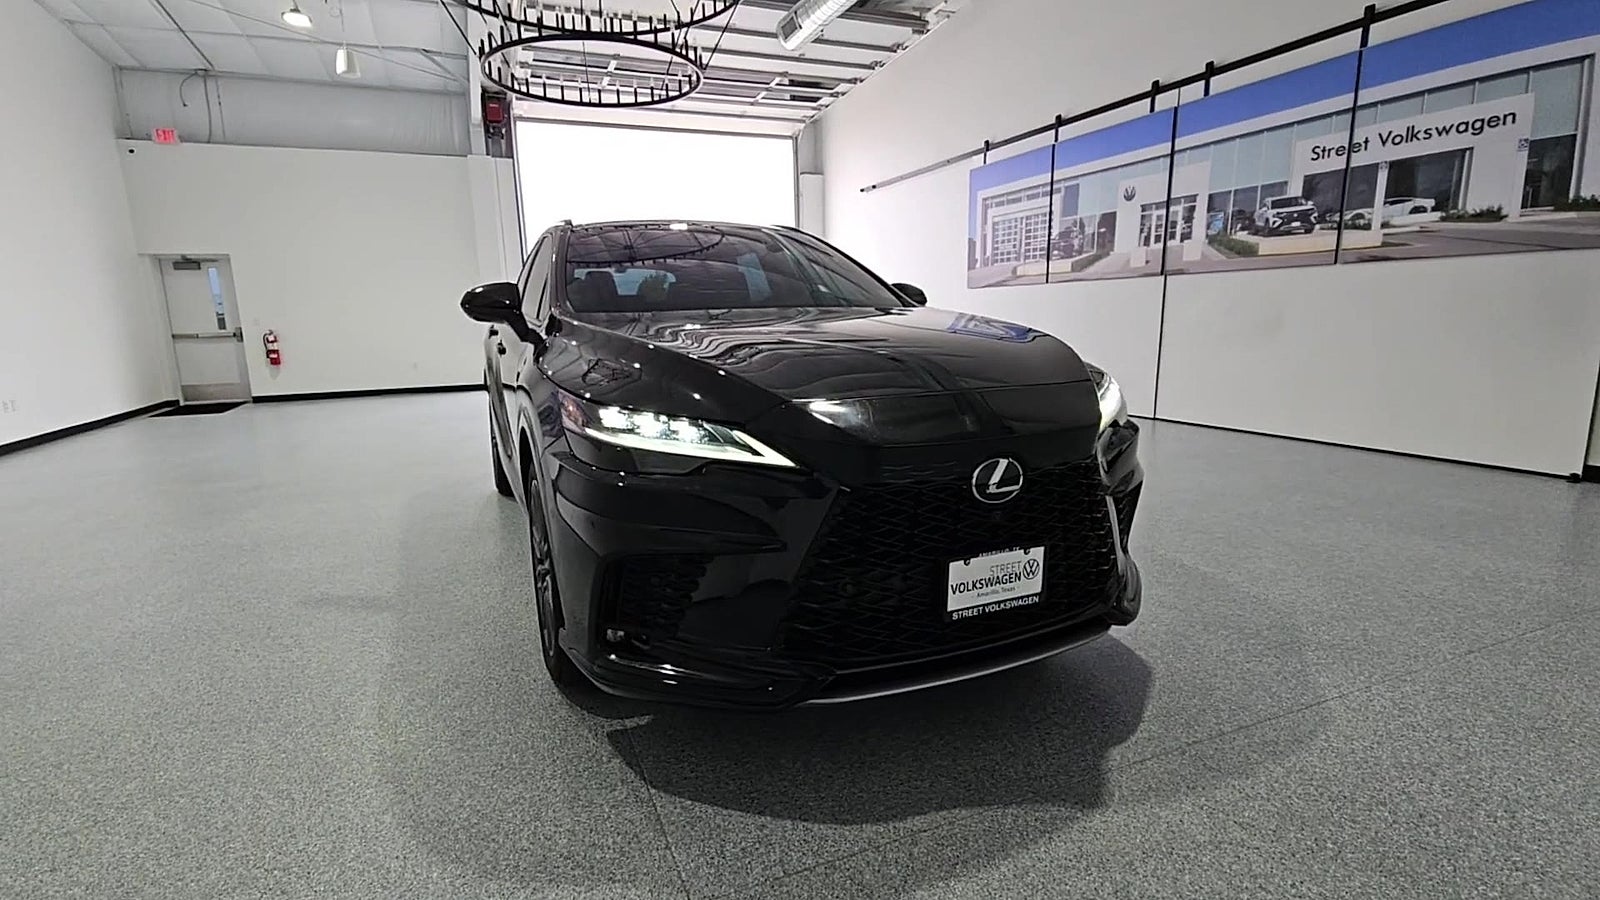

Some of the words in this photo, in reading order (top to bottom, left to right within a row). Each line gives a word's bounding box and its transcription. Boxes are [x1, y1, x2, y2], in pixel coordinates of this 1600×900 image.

[1310, 136, 1371, 162] Street
[1378, 111, 1517, 148] Volkswagen
[989, 560, 1022, 577] STREET
[950, 571, 1022, 596] VOLKSWAGEN
[952, 606, 983, 620] STREET
[984, 595, 1040, 613] VOLKSWAGEN
